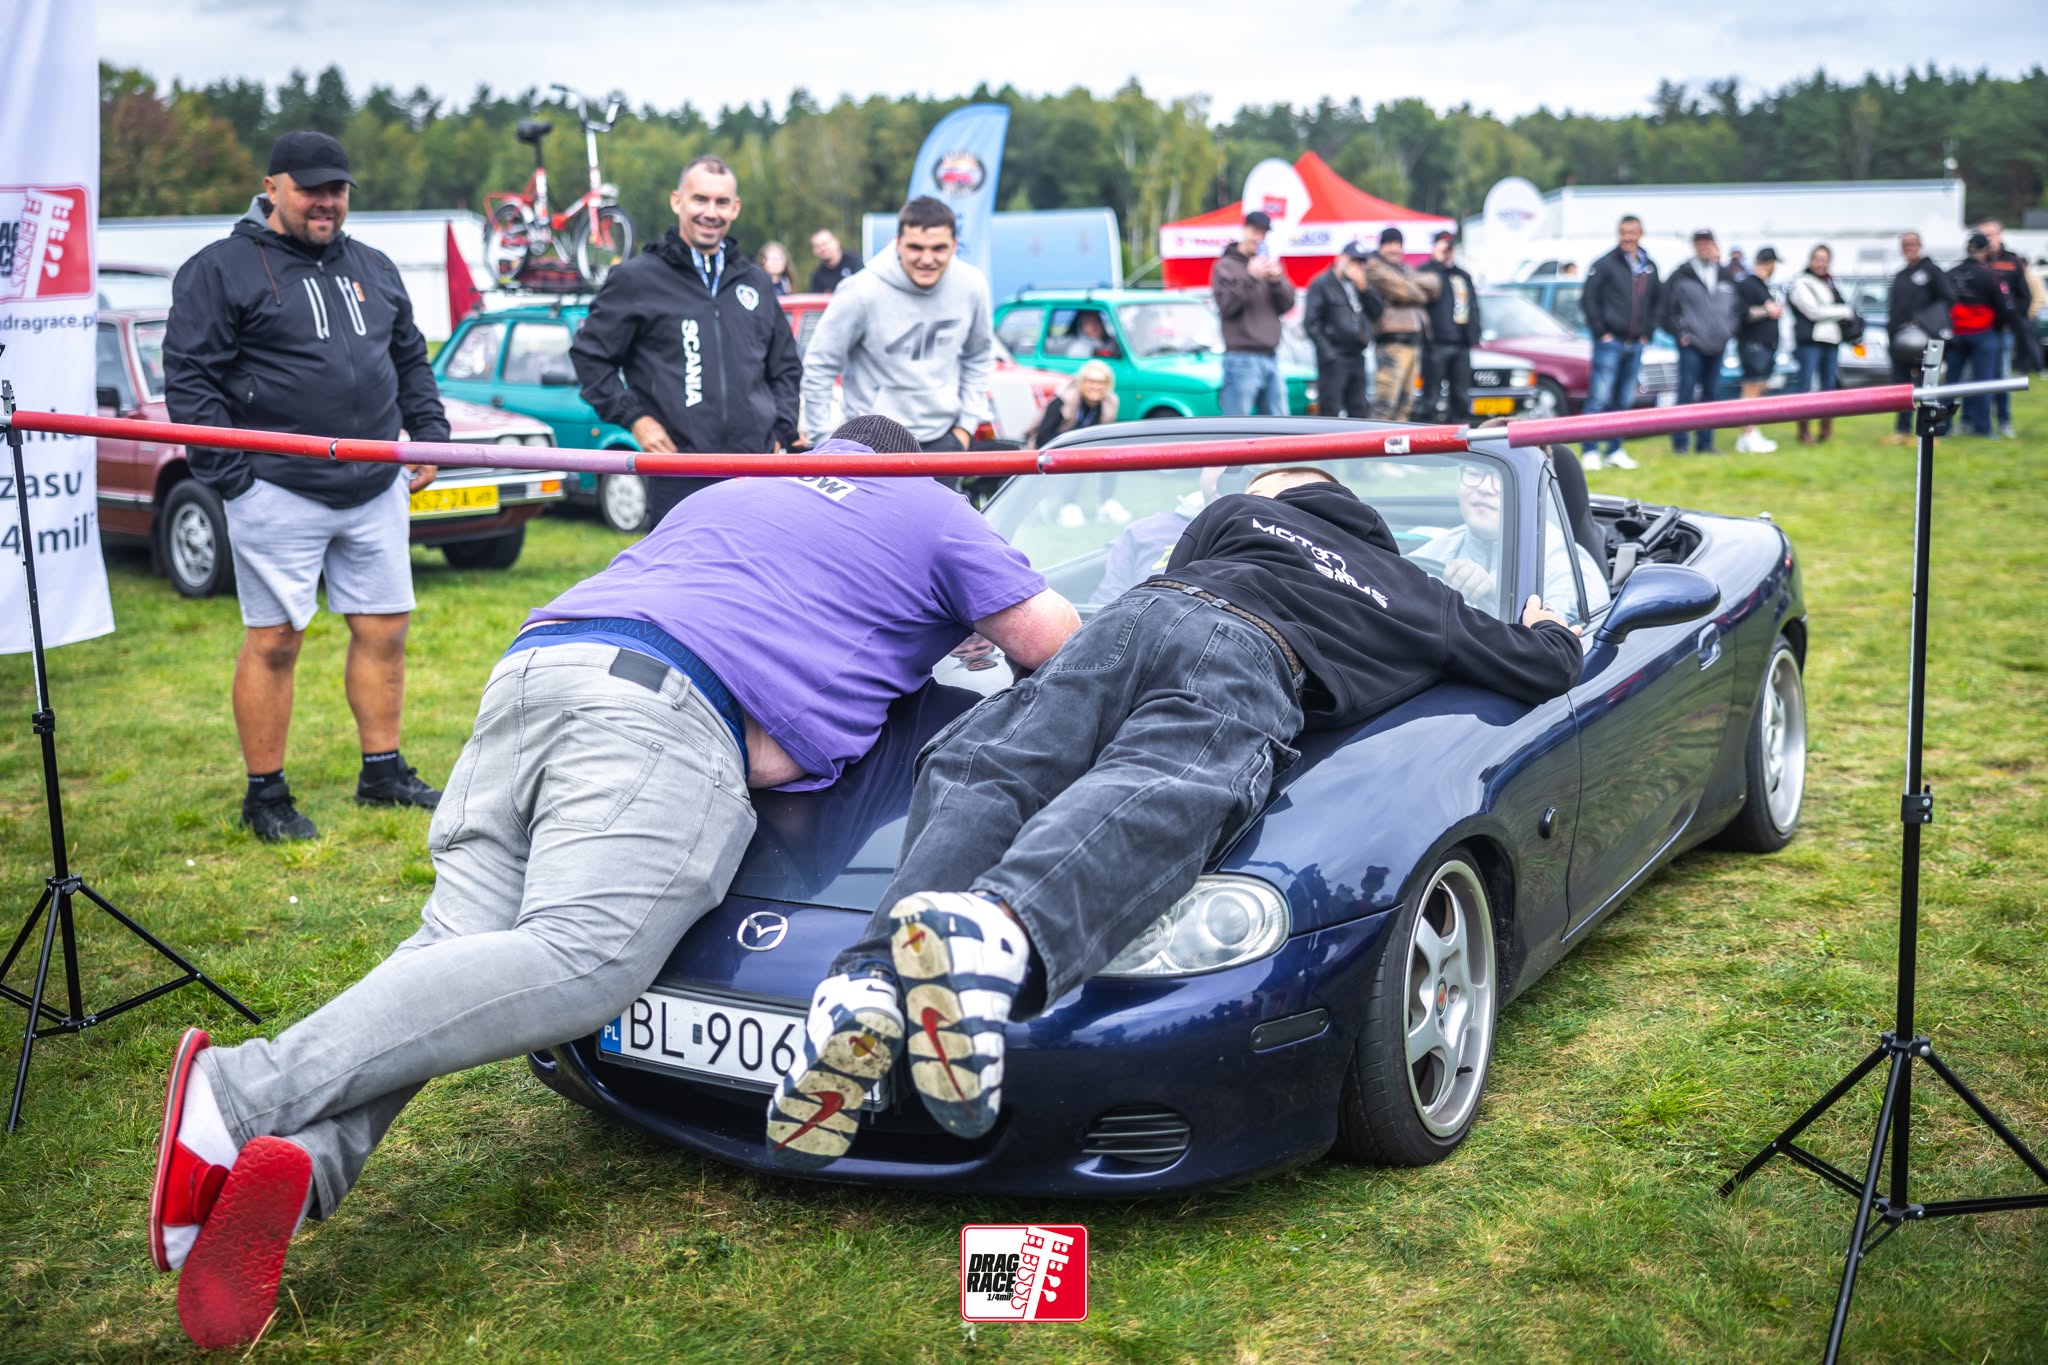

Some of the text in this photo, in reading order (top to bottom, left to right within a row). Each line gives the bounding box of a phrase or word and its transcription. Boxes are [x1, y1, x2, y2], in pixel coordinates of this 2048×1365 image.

[0, 312, 97, 334] dragrace.pl
[681, 319, 703, 408] SCANIA
[37, 512, 95, 555] mil
[604, 1025, 619, 1041] PL
[630, 997, 796, 1077] BL 906
